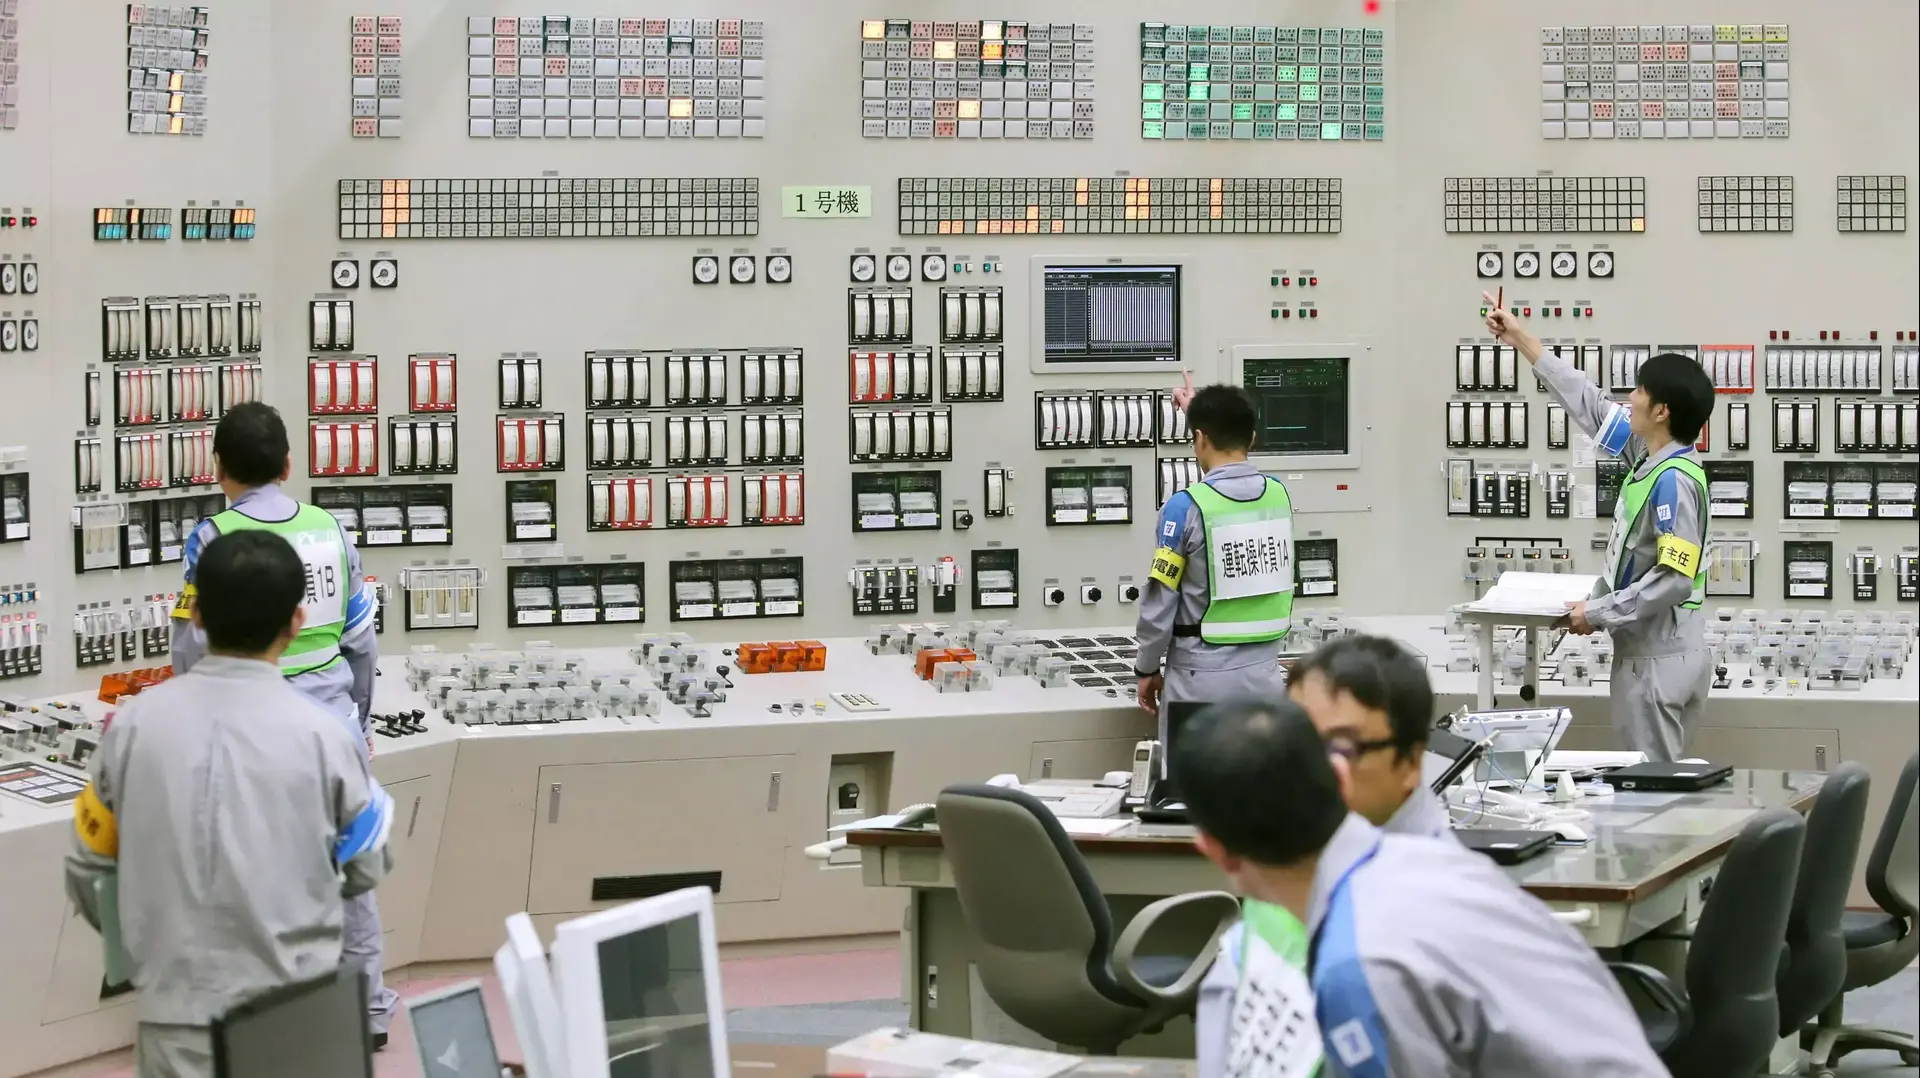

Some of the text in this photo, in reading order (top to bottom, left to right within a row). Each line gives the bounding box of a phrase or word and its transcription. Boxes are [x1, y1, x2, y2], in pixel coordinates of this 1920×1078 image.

[796, 190, 859, 214] 1号機
[1153, 557, 1180, 580] 電課
[1221, 536, 1289, 578] 運転操作員1A
